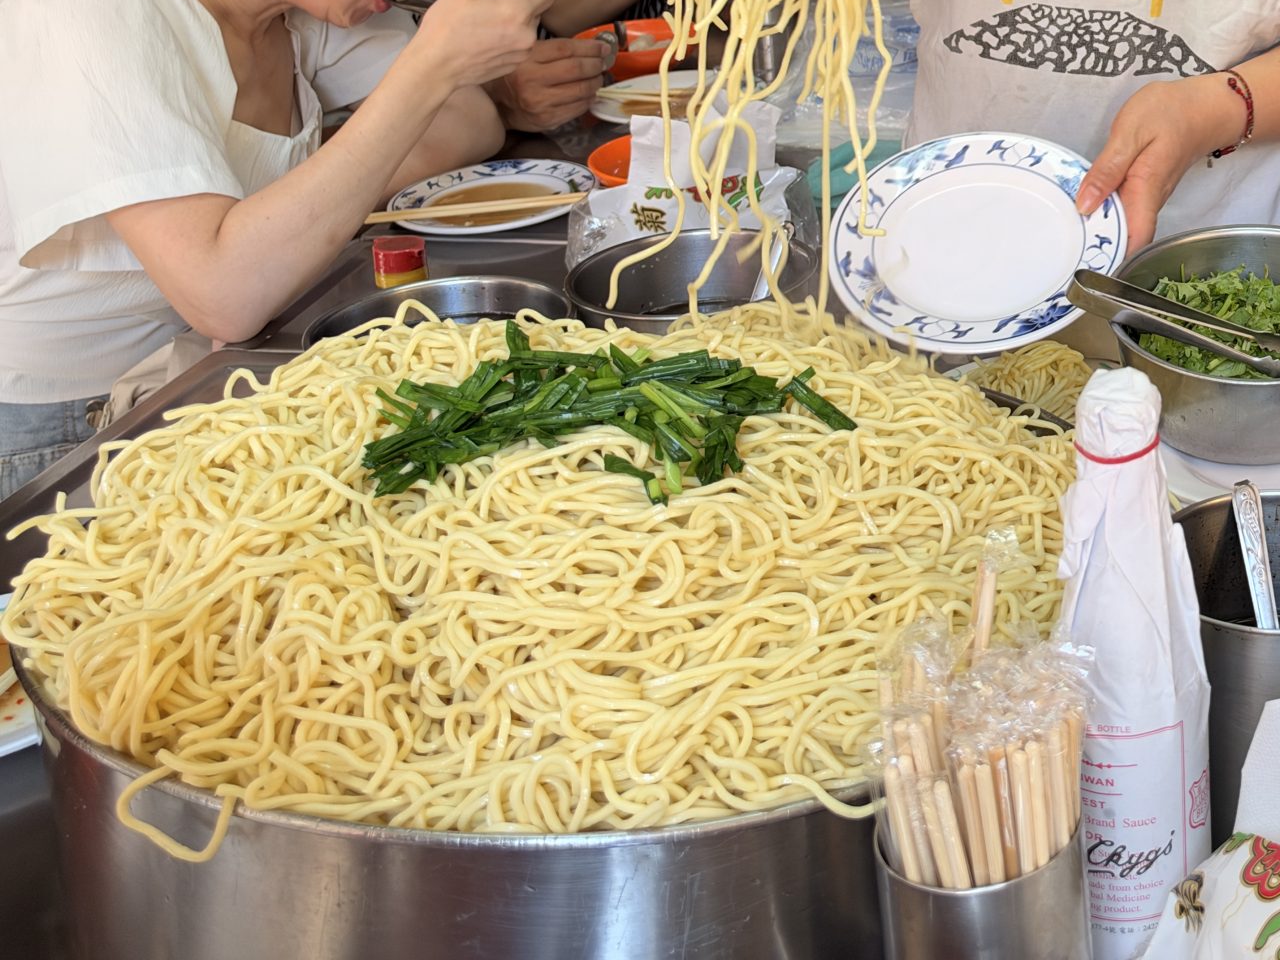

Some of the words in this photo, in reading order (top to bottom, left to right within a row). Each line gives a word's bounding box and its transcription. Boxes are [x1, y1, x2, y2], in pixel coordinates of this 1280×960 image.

[630, 202, 667, 232] 菊
[1097, 725, 1132, 733] BOTTLE
[1082, 797, 1106, 809] EST
[1122, 817, 1157, 828] Sauce
[1109, 882, 1131, 891] from
[1134, 880, 1165, 891] choice
[1106, 893, 1151, 903] Medicine
